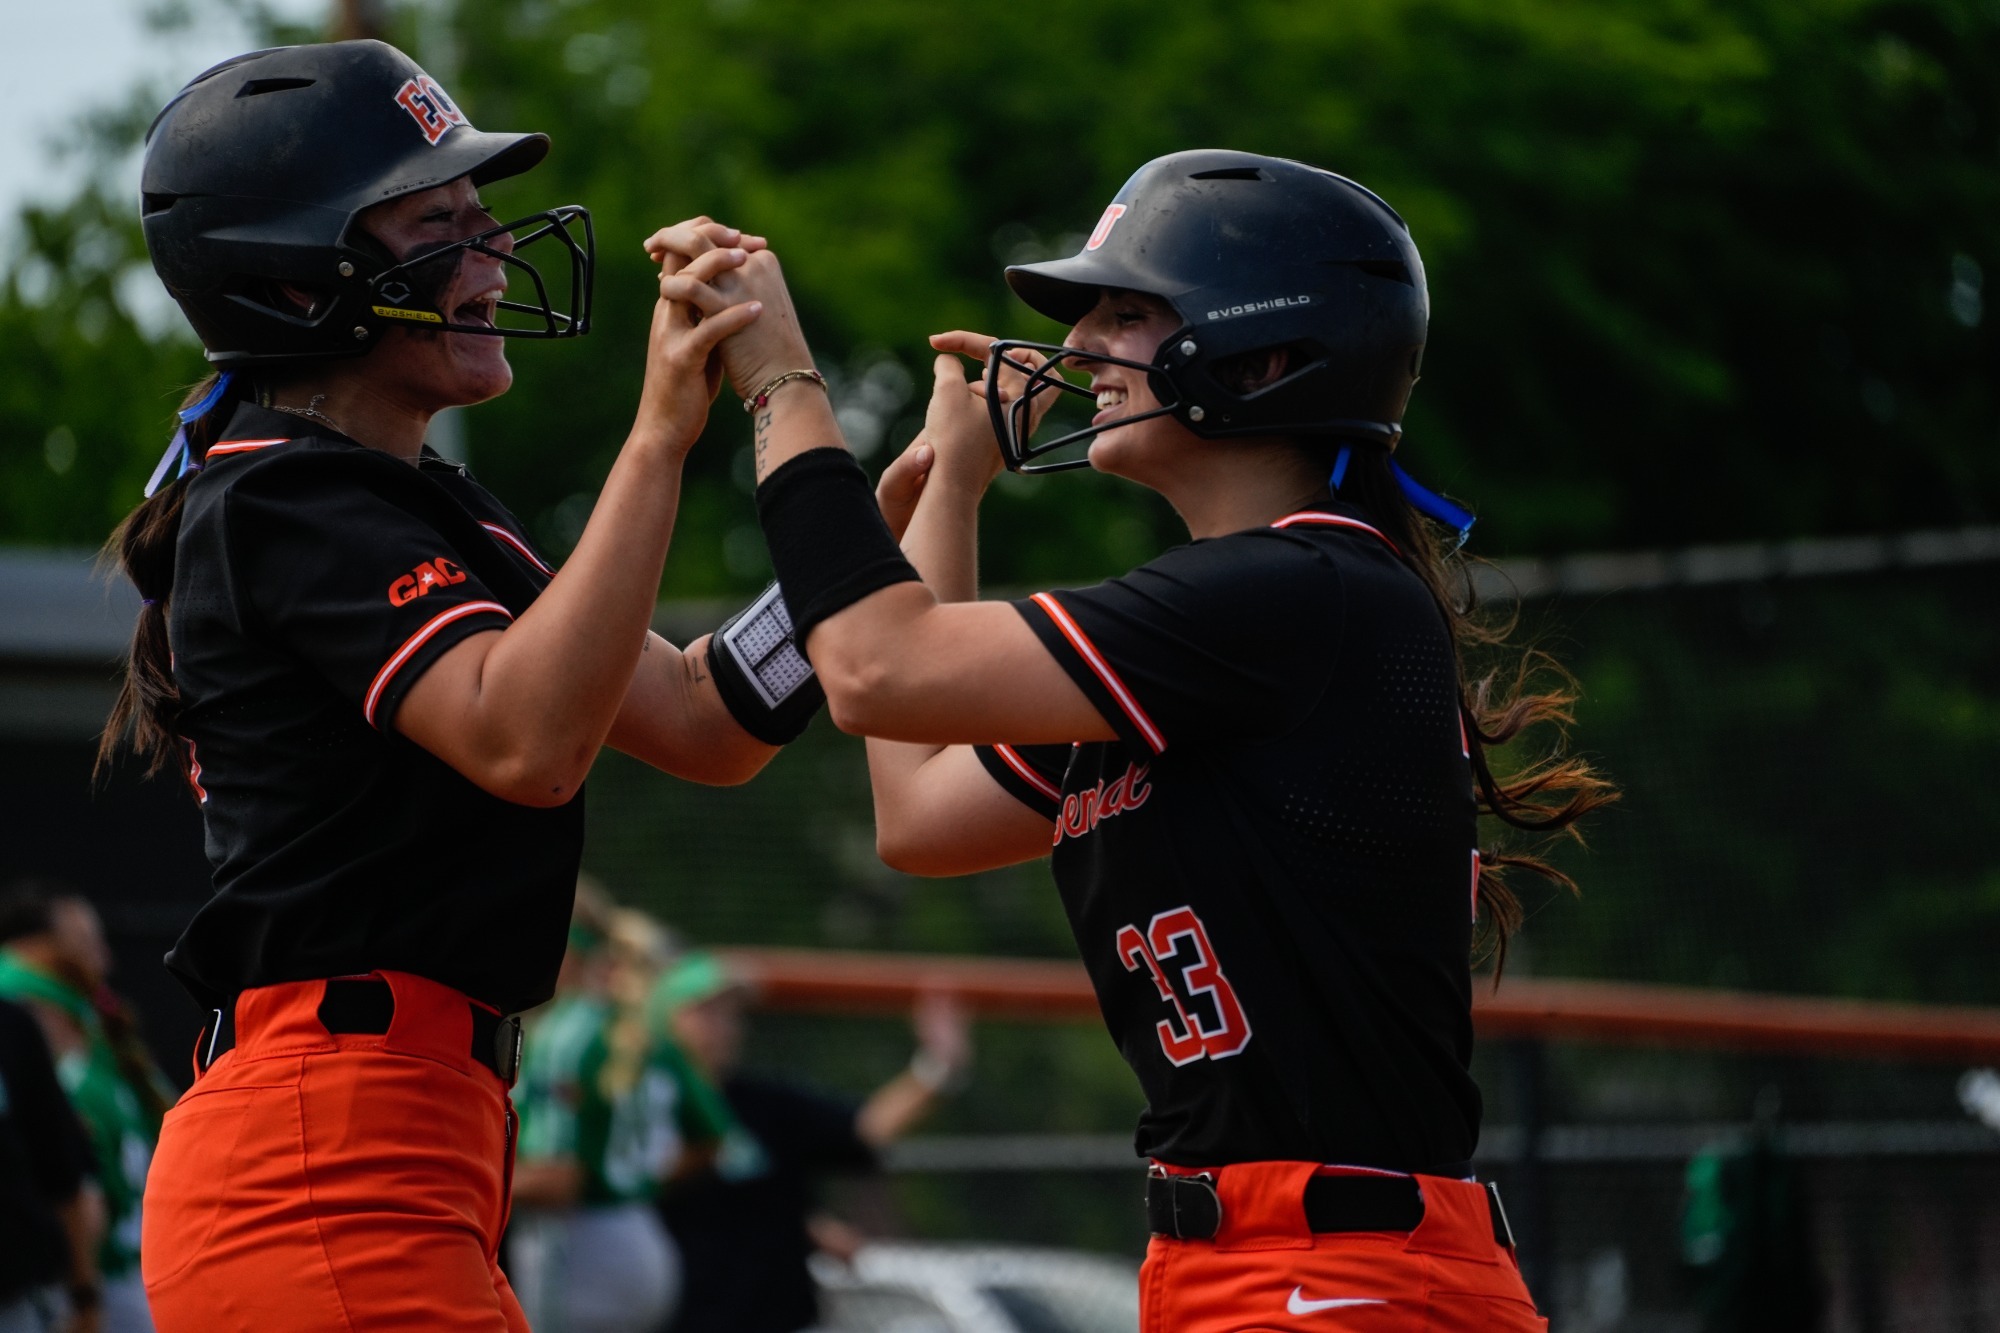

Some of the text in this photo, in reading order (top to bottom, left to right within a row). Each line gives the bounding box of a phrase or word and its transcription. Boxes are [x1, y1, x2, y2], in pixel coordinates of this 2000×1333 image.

[377, 308, 437, 321] EVOSHIELD
[1207, 295, 1311, 320] EVOSHIELD
[388, 557, 467, 608] GAC
[1116, 905, 1253, 1068] 33
